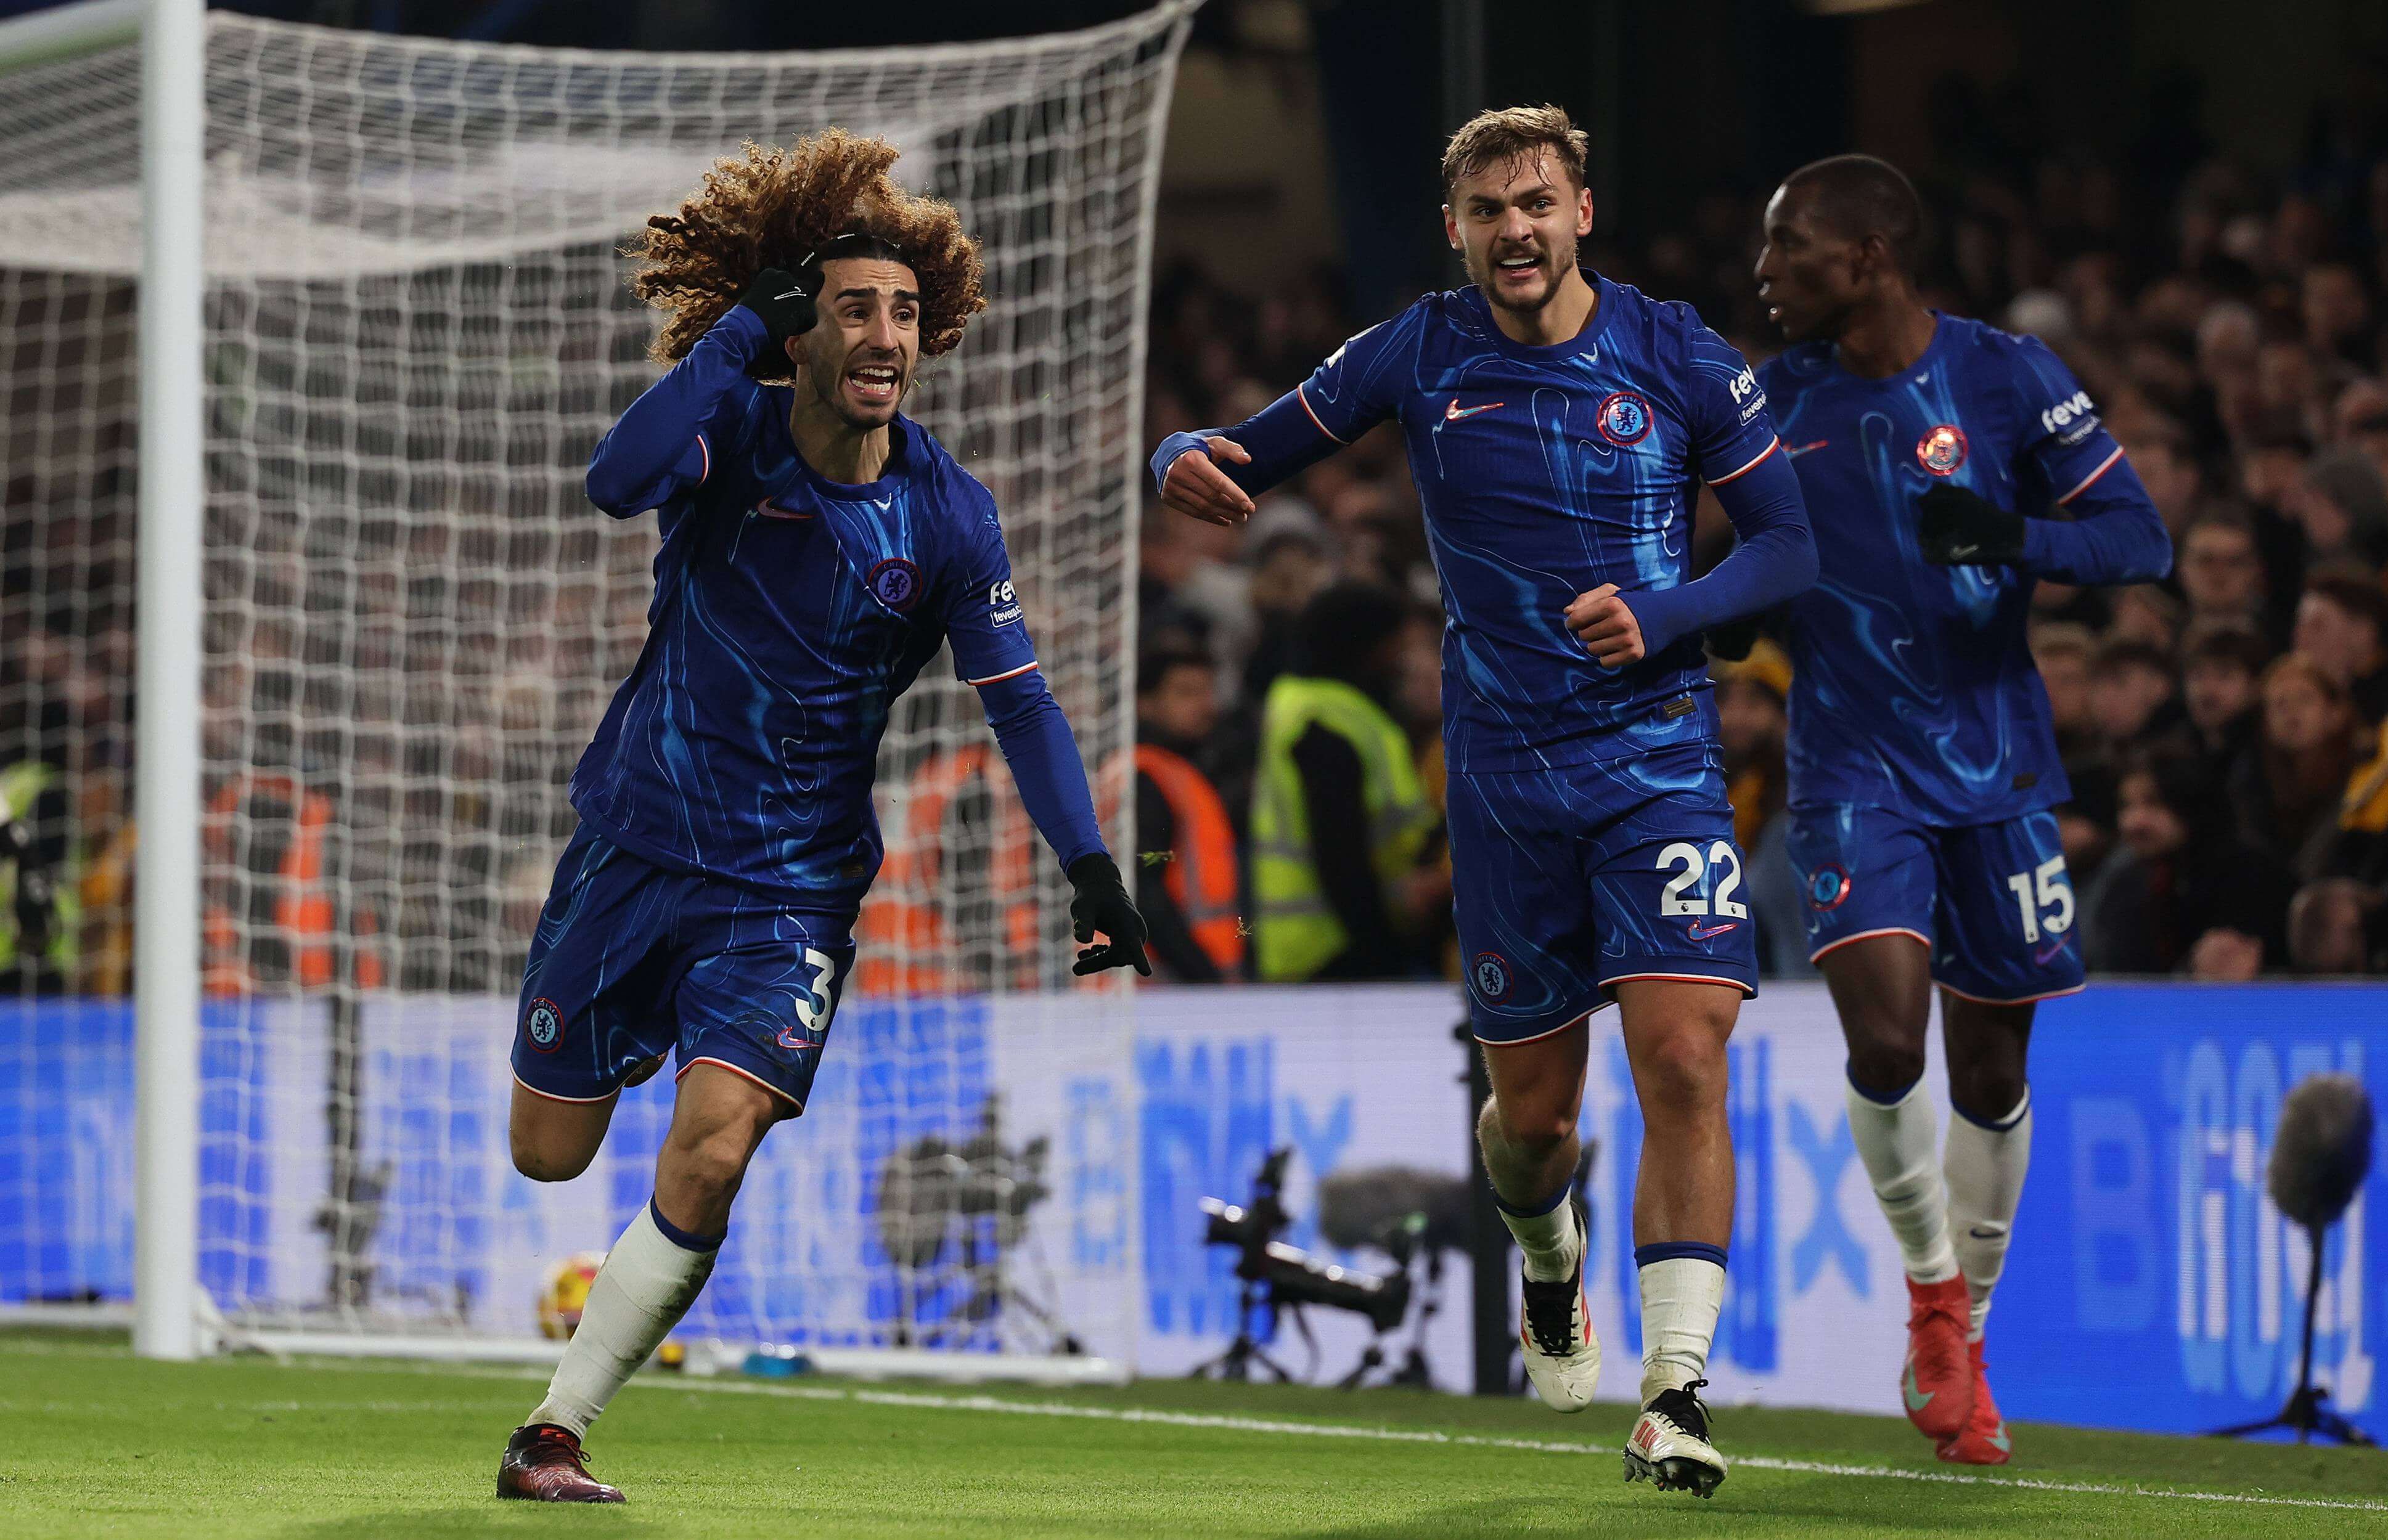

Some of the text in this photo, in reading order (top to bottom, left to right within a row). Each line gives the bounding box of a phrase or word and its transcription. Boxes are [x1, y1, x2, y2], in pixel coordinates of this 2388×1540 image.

[1656, 841, 1748, 920] 22
[2008, 854, 2075, 944] 15
[795, 947, 835, 1032] 3
